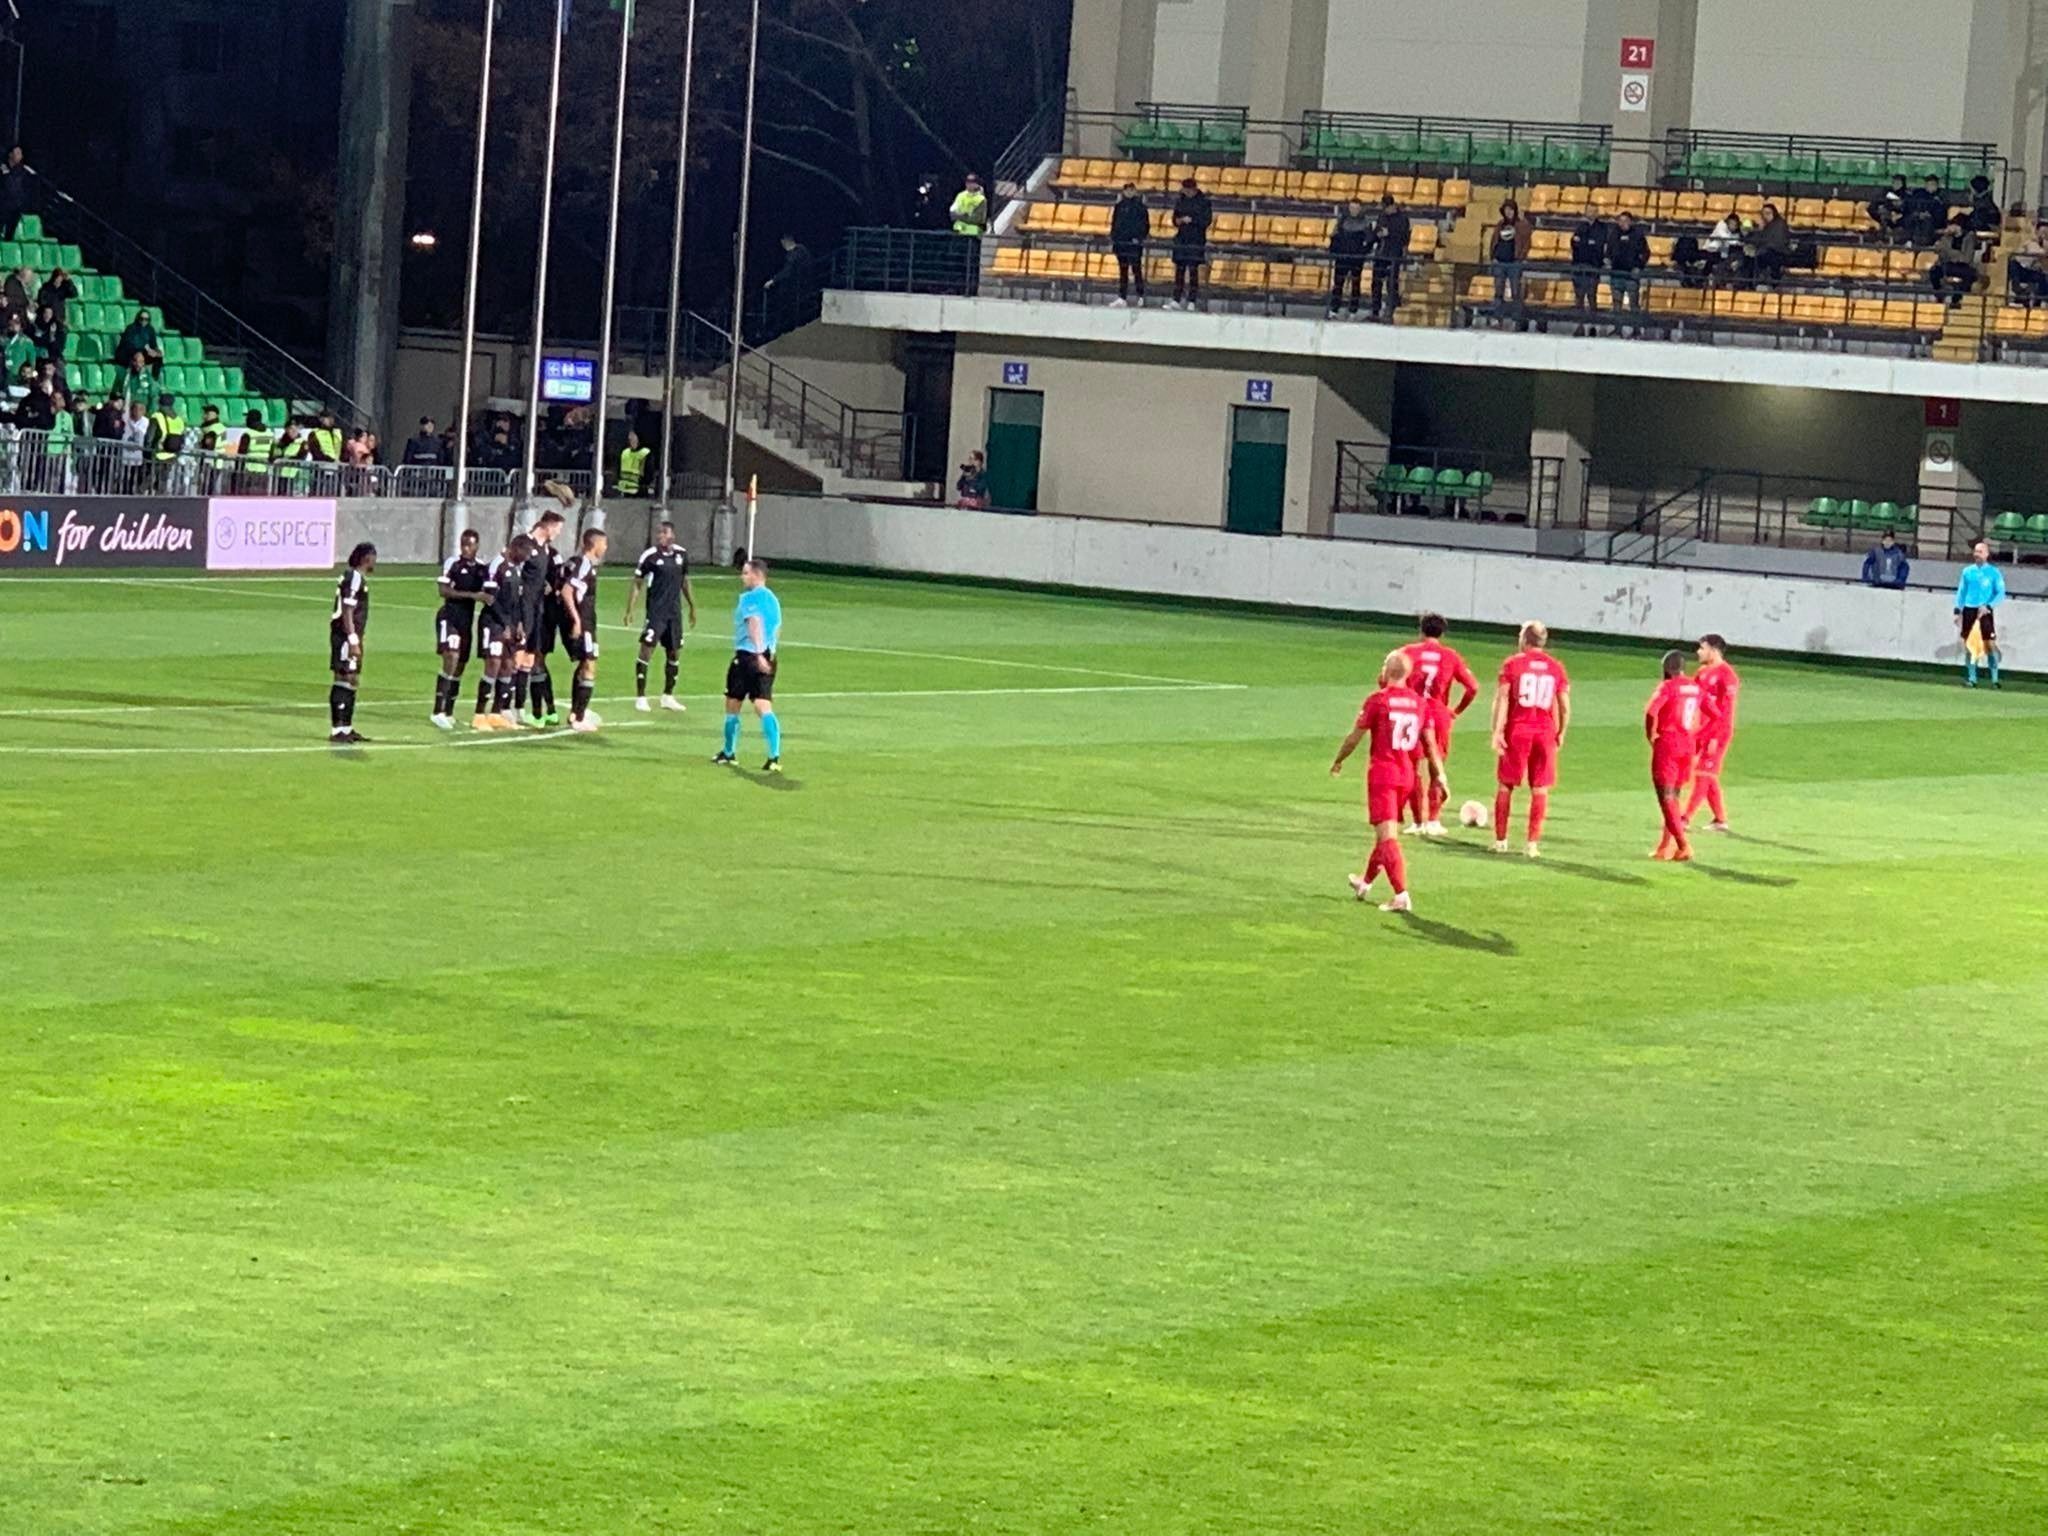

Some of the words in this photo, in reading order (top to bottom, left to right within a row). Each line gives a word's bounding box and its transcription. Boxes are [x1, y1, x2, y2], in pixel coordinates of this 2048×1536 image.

[1628, 45, 1648, 62] 21
[1008, 374, 1024, 384] WC
[1251, 391, 1267, 401] WC
[1939, 404, 1947, 419] 1
[55, 509, 96, 566] for
[99, 512, 193, 552] children
[244, 521, 332, 547] RESPECT
[645, 628, 655, 643] 2
[1421, 664, 1438, 699] 7
[1518, 672, 1556, 709] 90
[1388, 711, 1419, 751] 73
